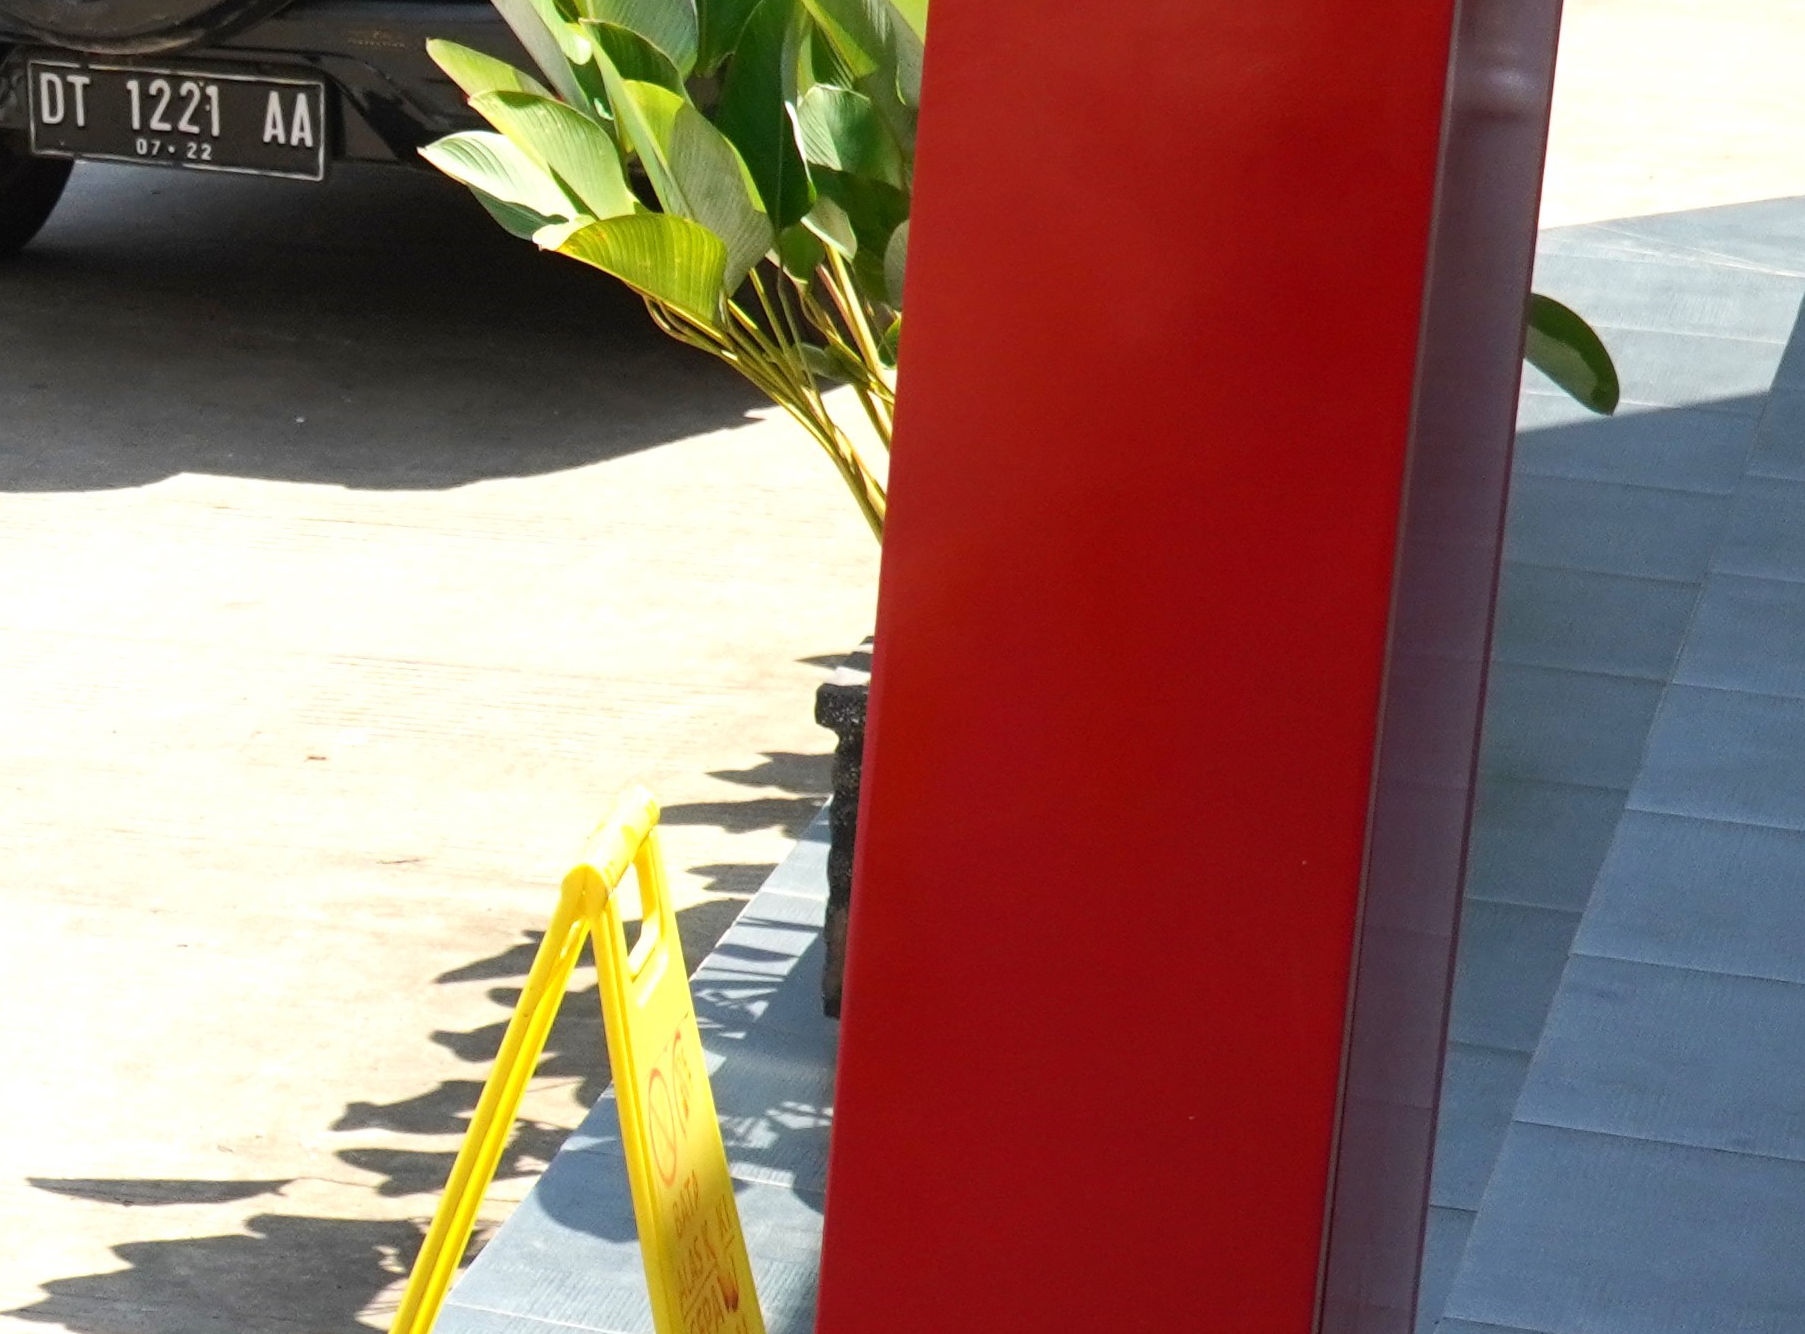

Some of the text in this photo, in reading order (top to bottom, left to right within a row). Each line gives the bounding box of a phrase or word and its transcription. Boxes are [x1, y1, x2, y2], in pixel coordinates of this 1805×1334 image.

[39, 72, 314, 148] DT 1221 AA
[136, 138, 212, 161] 07 22
[700, 1193, 732, 1267] KKI
